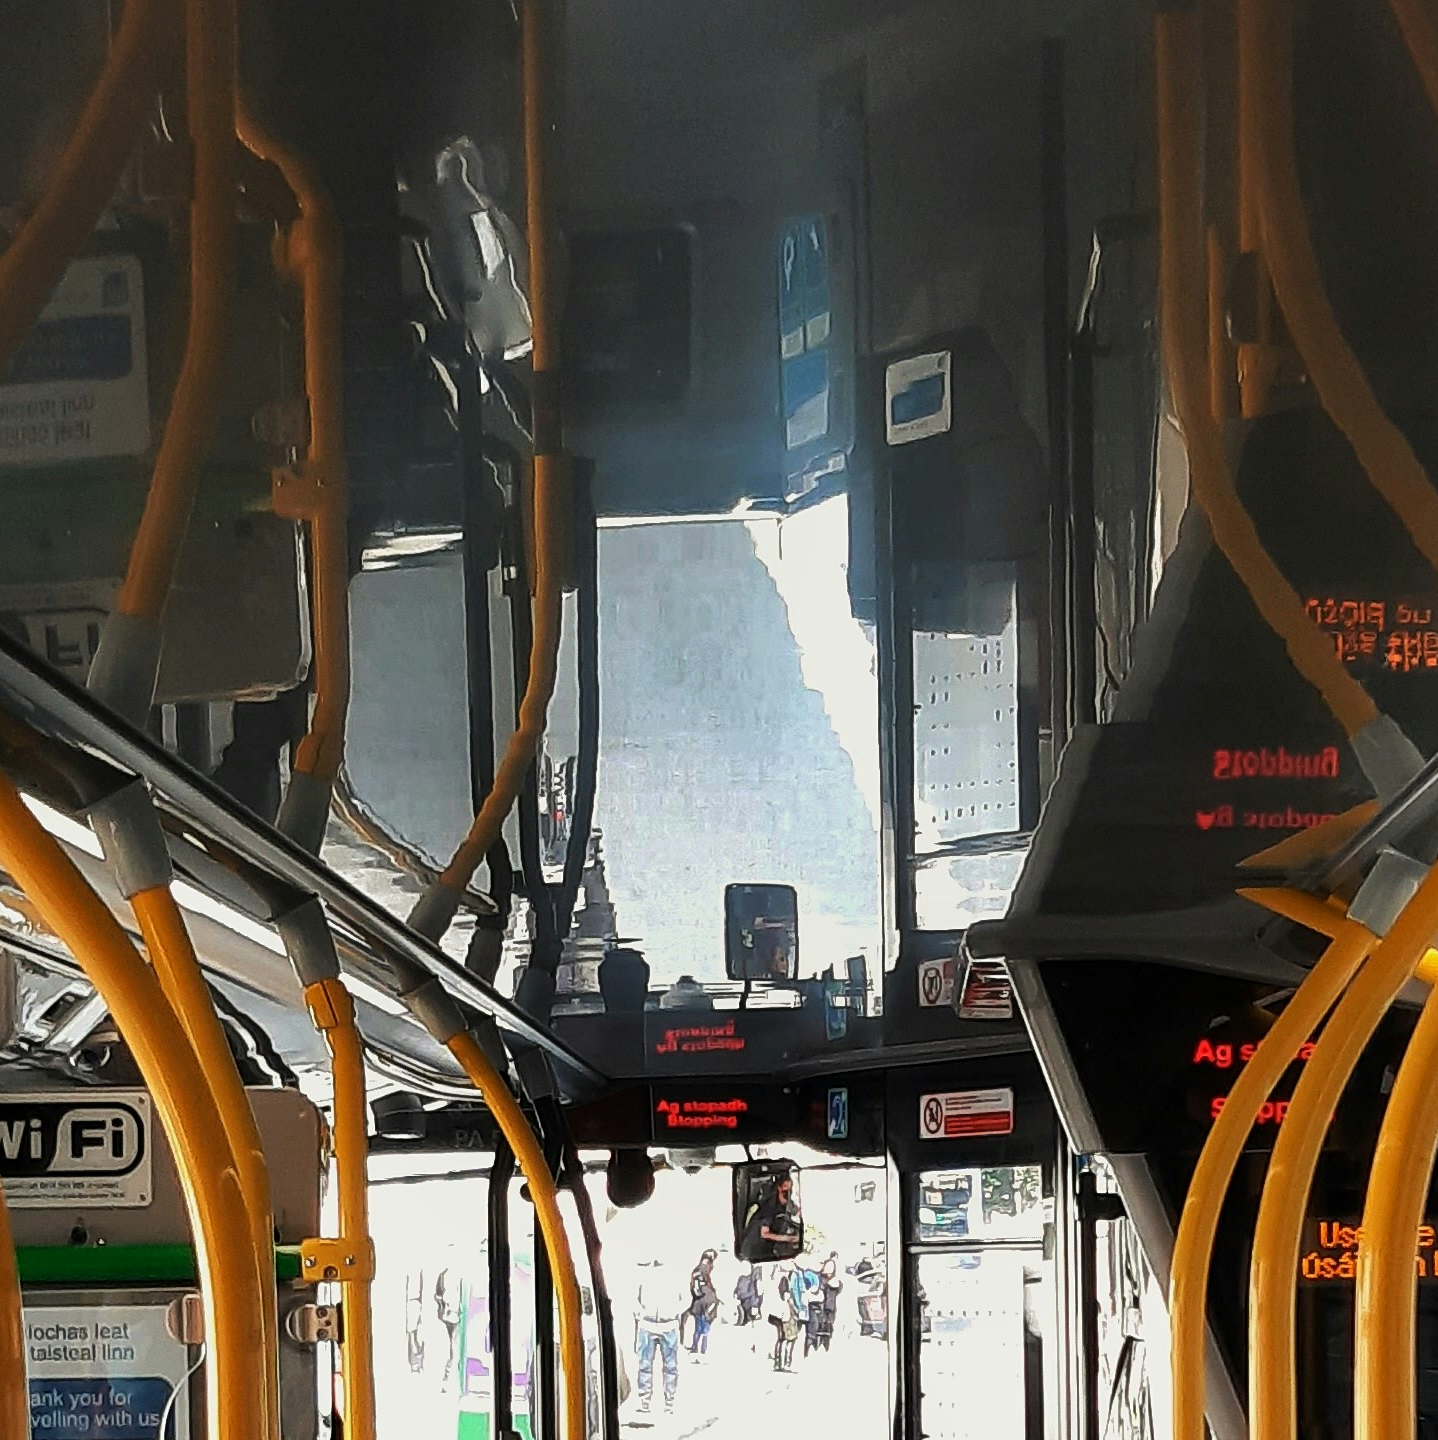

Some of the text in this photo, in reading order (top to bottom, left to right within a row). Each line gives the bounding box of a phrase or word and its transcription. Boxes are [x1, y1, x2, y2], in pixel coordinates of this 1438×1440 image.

[1193, 1039, 1232, 1068] Ag
[95, 1322, 130, 1340] leat
[31, 1388, 64, 1407] ank
[69, 1393, 103, 1411] you
[32, 1410, 161, 1431] velling with us
